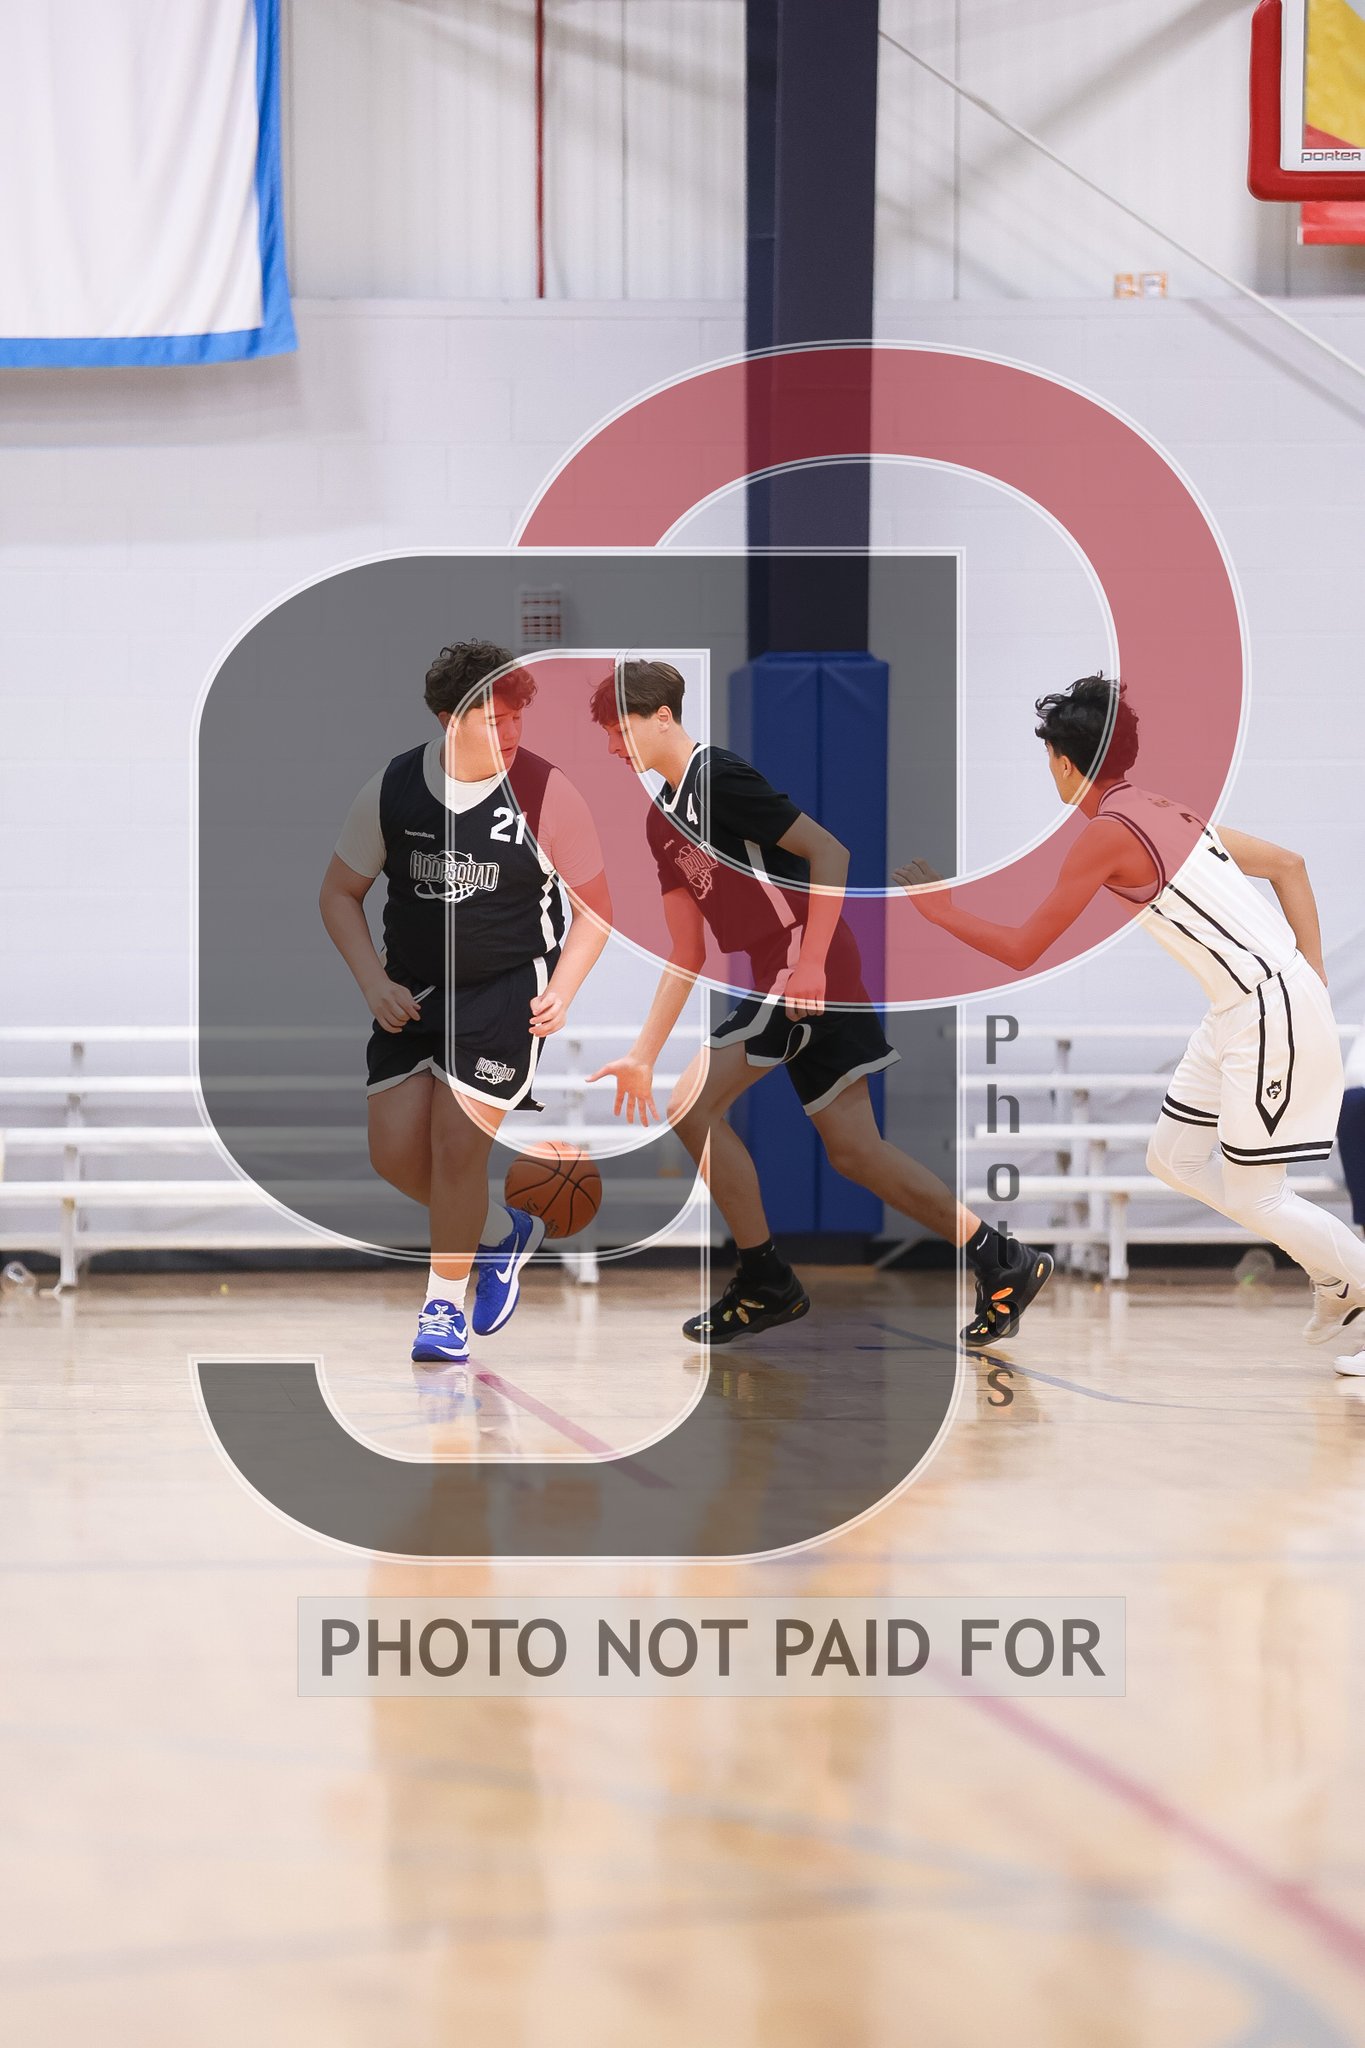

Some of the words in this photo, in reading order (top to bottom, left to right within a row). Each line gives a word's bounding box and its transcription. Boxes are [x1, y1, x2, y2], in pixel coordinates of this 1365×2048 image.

[489, 806, 528, 845] 21
[686, 793, 699, 825] 4
[411, 851, 499, 890] HOOPSQUAD
